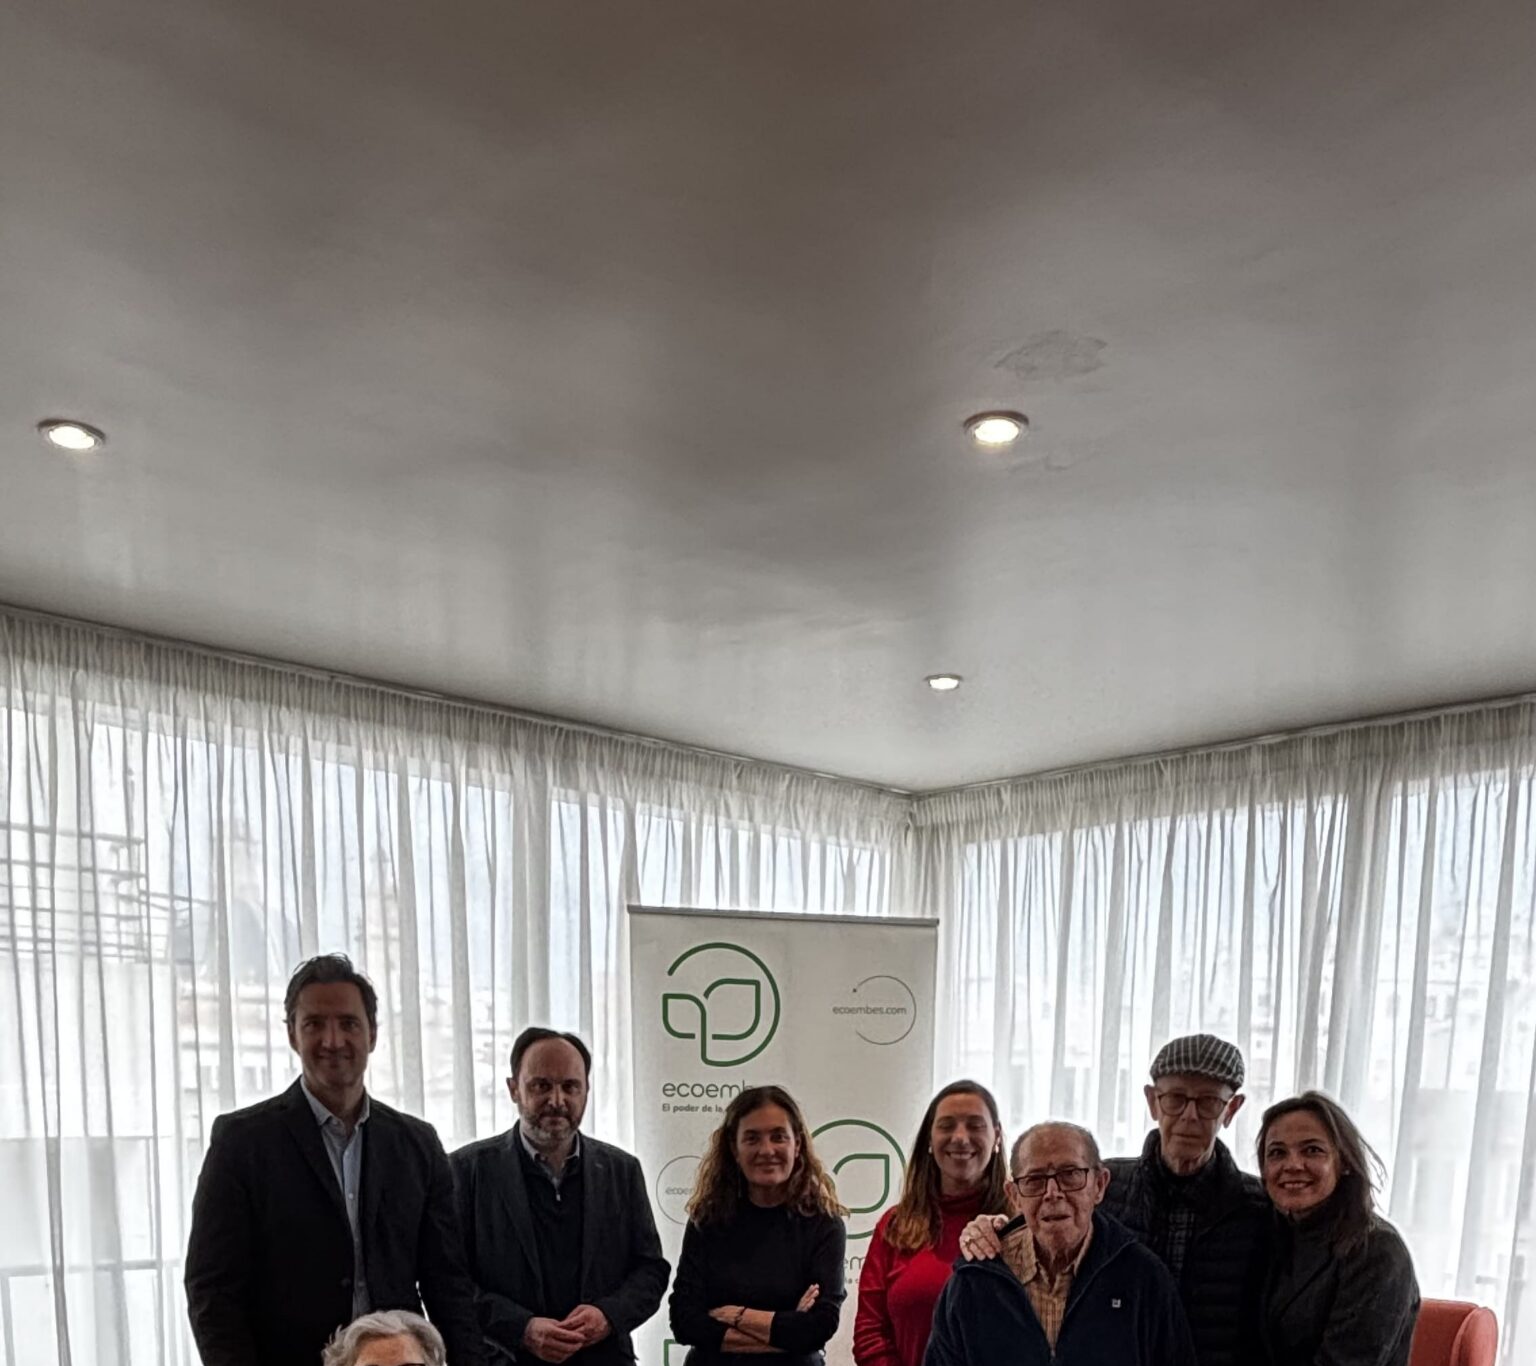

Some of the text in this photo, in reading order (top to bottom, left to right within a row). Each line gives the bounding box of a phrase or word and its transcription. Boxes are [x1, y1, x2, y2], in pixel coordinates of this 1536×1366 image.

[832, 1004, 907, 1014] ecoembes.com
[662, 1103, 670, 1112] El
[673, 1104, 699, 1113] poder
[702, 1104, 712, 1112] de
